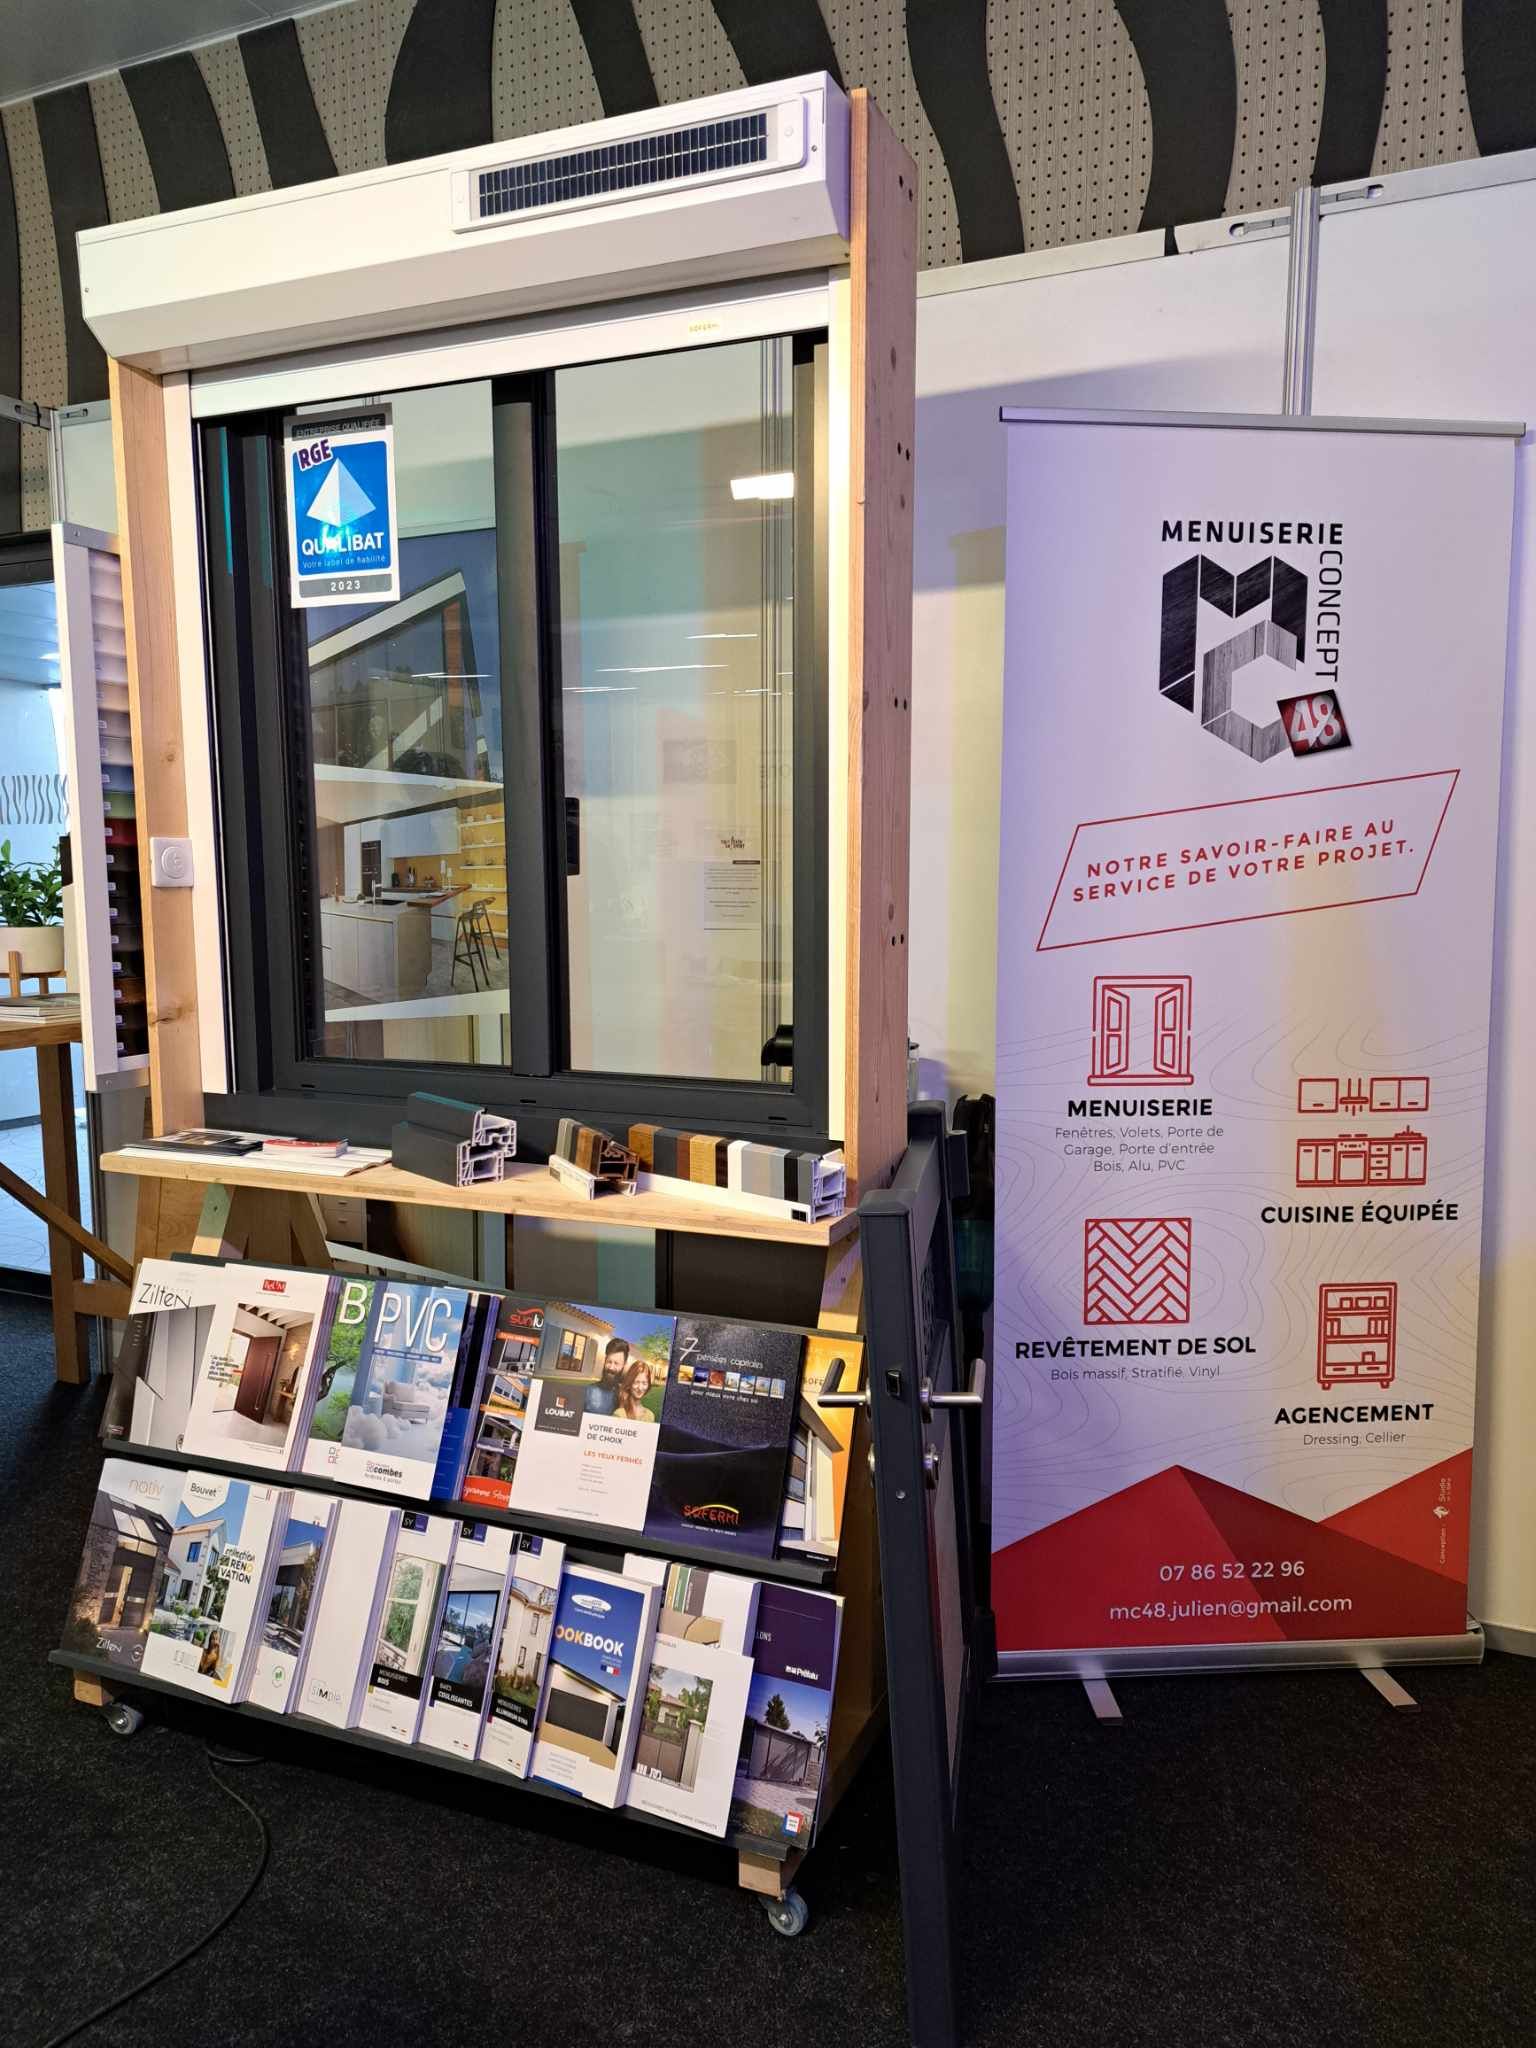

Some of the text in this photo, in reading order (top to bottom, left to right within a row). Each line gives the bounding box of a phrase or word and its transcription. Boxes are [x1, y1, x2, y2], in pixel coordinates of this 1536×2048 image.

[298, 439, 332, 470] RGE
[1161, 520, 1343, 545] MENUISERIE
[301, 532, 385, 556] QUALIBAT
[330, 580, 361, 592] 2023
[1314, 550, 1343, 683] CONCEPT
[1290, 694, 1342, 747] 48
[1087, 819, 1394, 878] NOTRE SAVOIR-FAIRE AU
[1073, 840, 1414, 902] SERVICE DE VOTRE PROJET.
[1068, 1099, 1213, 1117] MENUISERIE
[1055, 1126, 1224, 1139] Fenêtres, Volets, Porte de
[1063, 1143, 1115, 1157] Garage,
[1119, 1143, 1154, 1155] Porte
[1093, 1159, 1185, 1173] Bois, Alu, PVC
[1260, 1199, 1459, 1224] CUISINE ÉQUIPÉE
[338, 1282, 369, 1325] B
[374, 1292, 452, 1352] PVC
[1015, 1336, 1256, 1359] REVÊTEMENT DE SOL
[1051, 1365, 1221, 1381] Bois massif, Stratifié, Vinyl
[545, 1407, 575, 1418] LOUBAT
[1274, 1403, 1435, 1425] AGENCEMENT
[586, 1432, 622, 1445] DE CHOIX
[588, 1423, 613, 1434] VOTRE
[614, 1427, 638, 1438] GUIDE
[1303, 1431, 1406, 1446] Dressing, Cellier
[583, 1448, 596, 1458] LES
[597, 1452, 614, 1462] YEUX
[190, 1482, 218, 1498] Bouvet
[683, 1504, 739, 1526] SOFERMI
[220, 1567, 251, 1585] VATION
[1159, 1560, 1305, 1581] 07 86 52 22 96
[1109, 1595, 1353, 1622] mc48.julien@gmail.com
[555, 1624, 625, 1658] OOKBOOK
